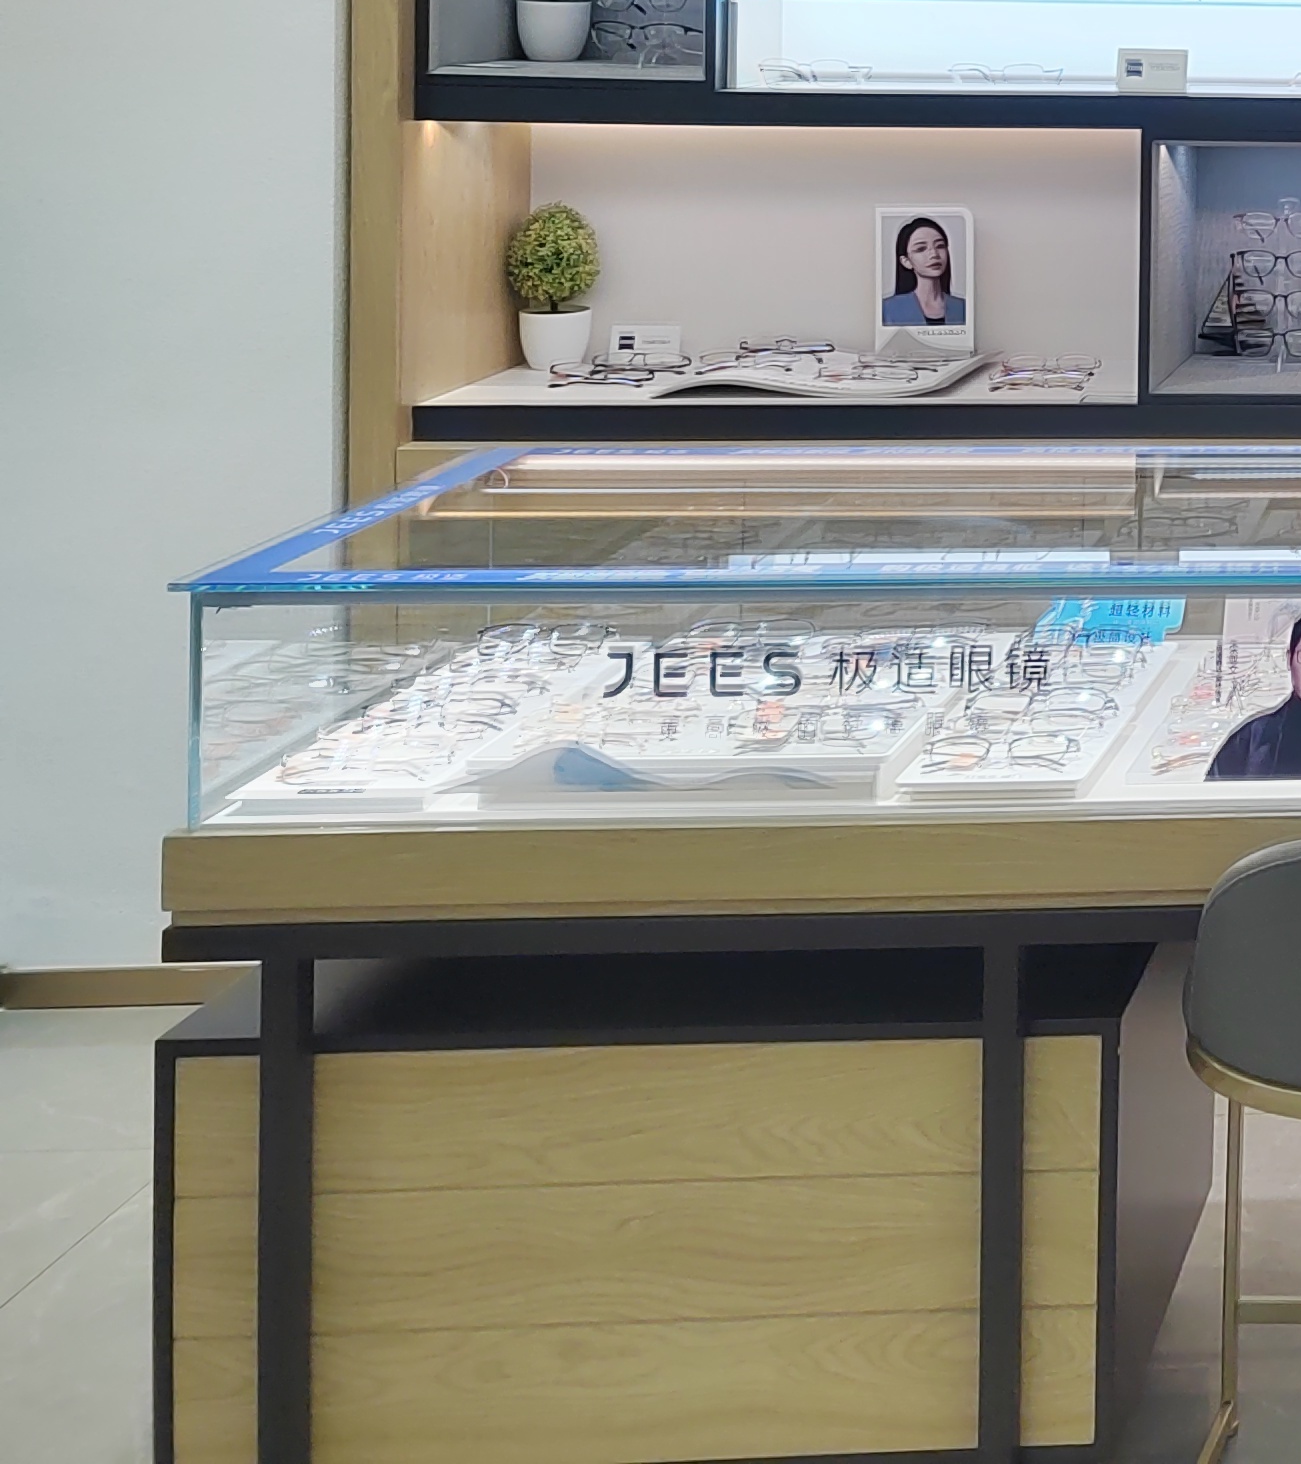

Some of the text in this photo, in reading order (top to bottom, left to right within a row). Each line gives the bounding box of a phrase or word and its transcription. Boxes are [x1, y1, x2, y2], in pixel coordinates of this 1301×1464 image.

[603, 650, 803, 698] JEES
[829, 644, 1054, 696] 极适眼镜
